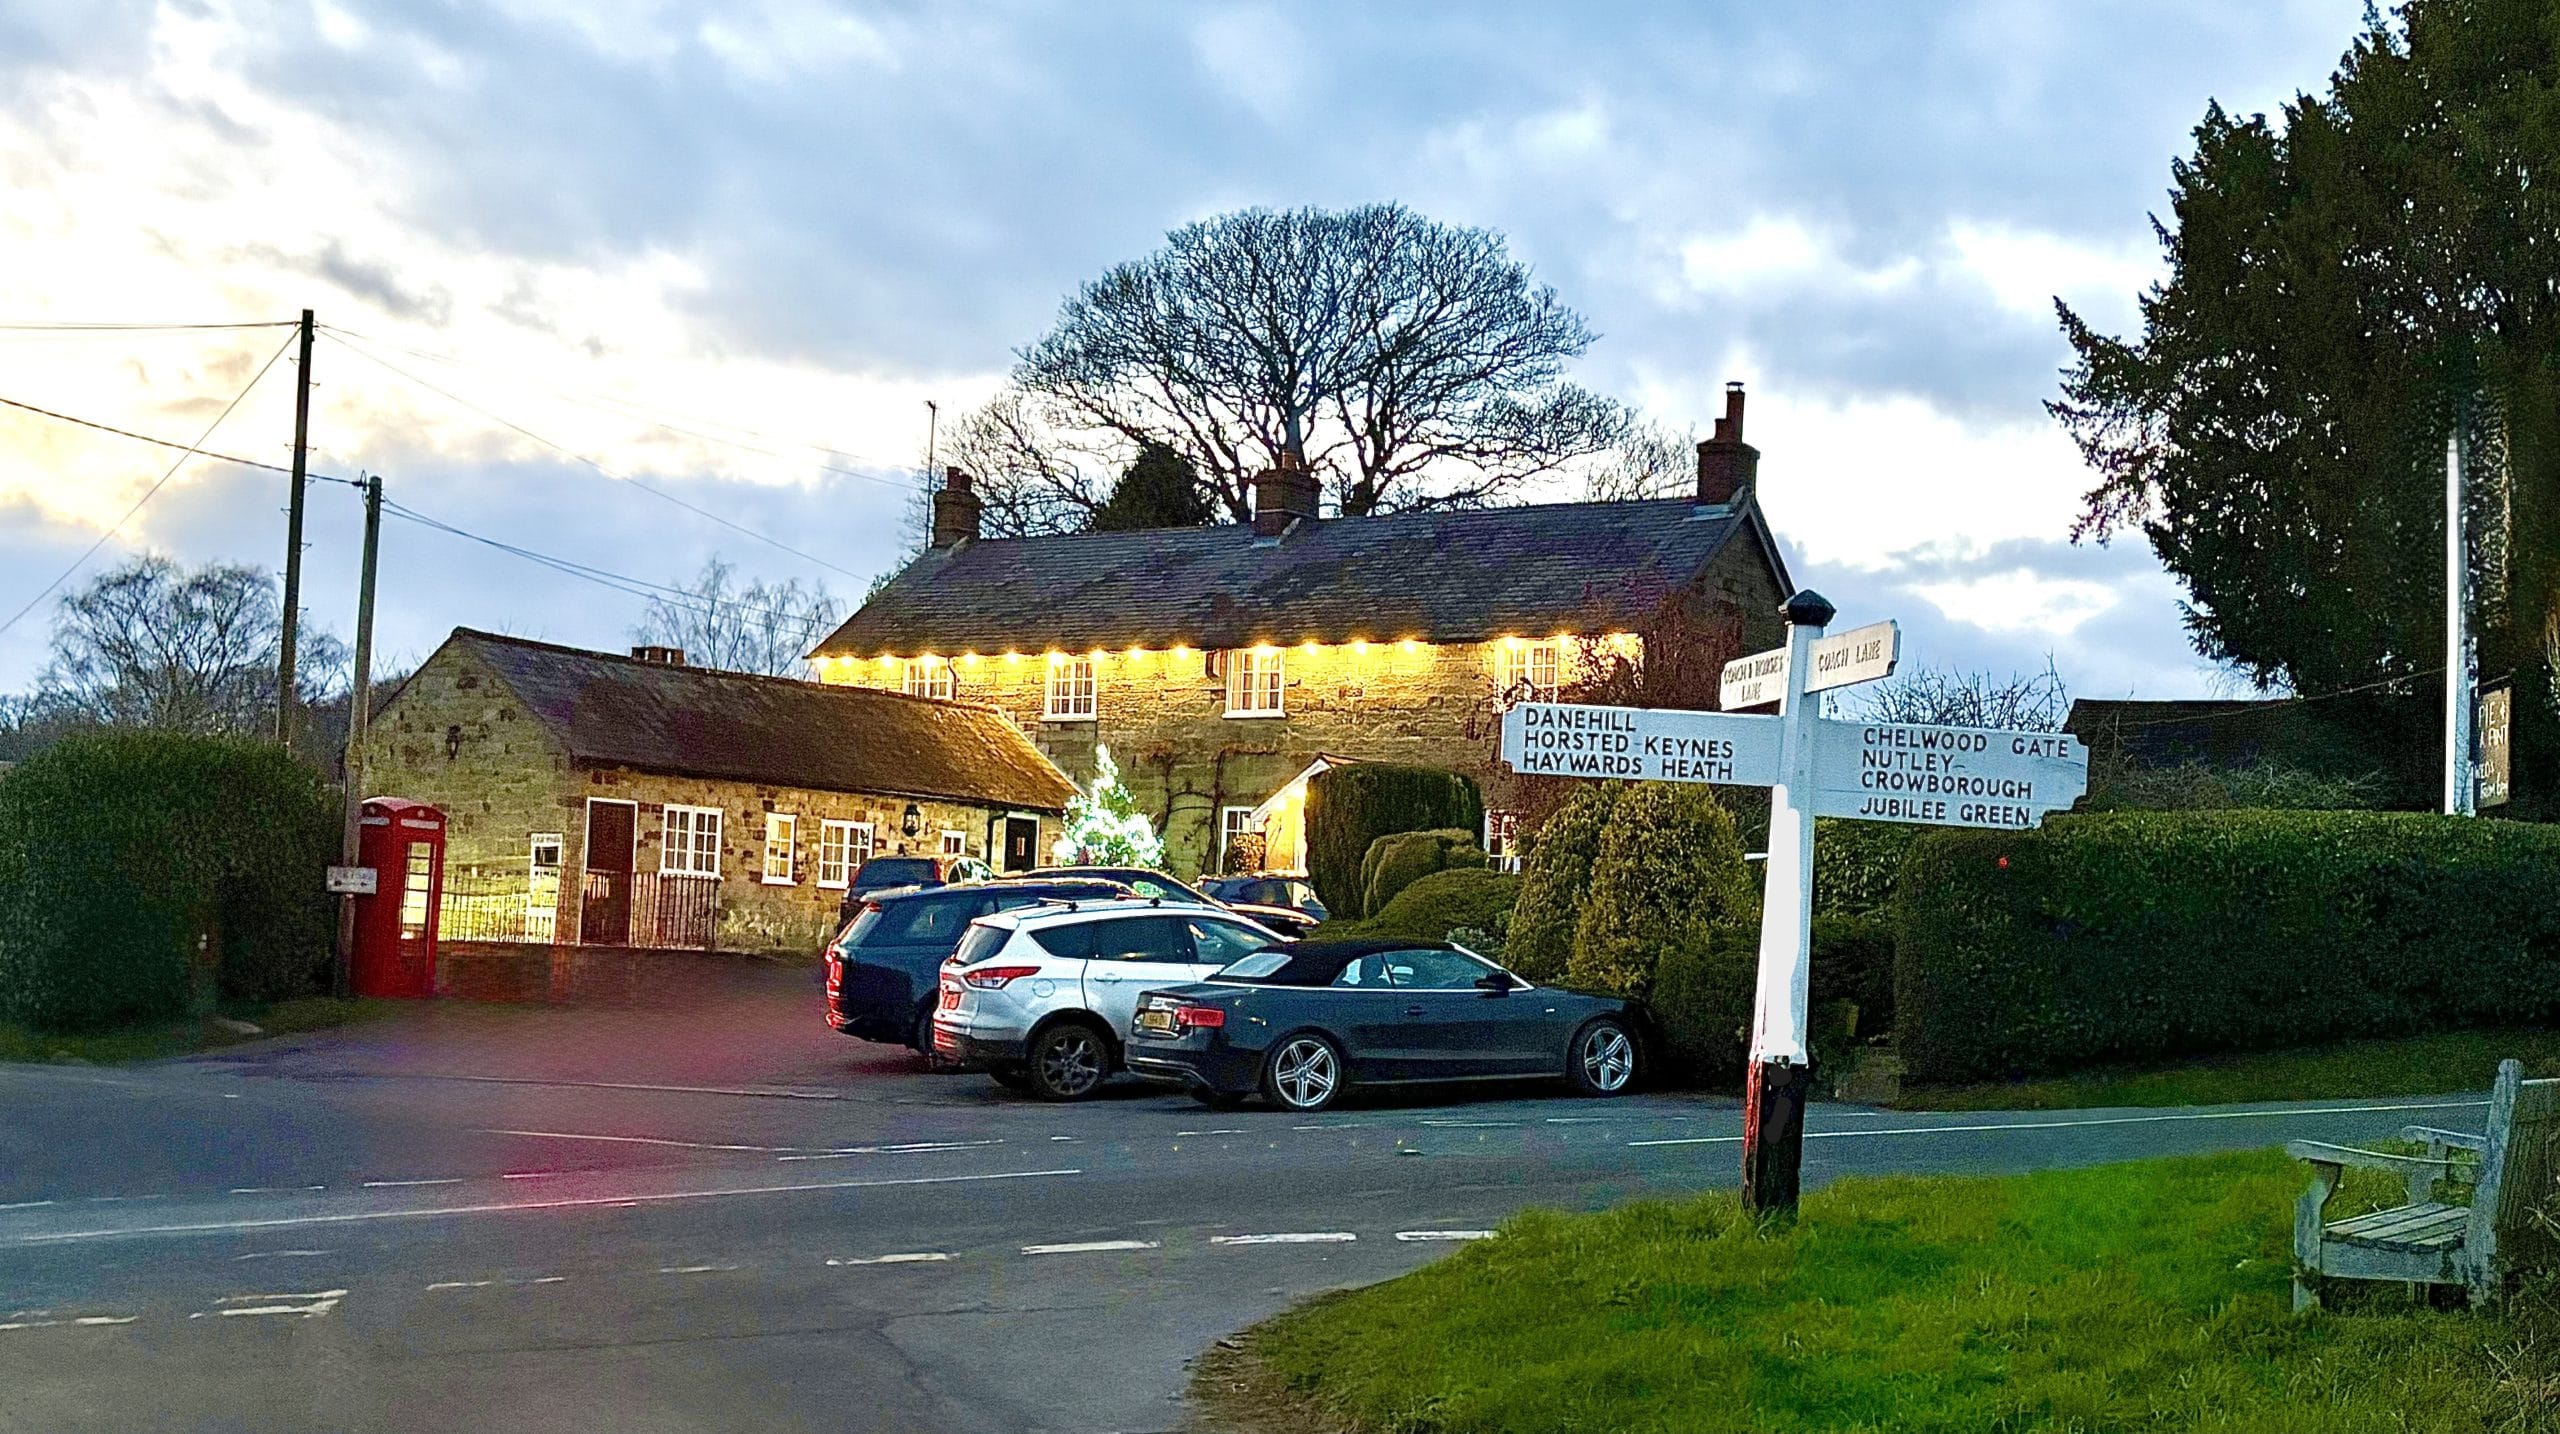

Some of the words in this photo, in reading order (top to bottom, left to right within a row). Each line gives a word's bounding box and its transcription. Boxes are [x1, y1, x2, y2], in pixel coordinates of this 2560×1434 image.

[1525, 707, 1637, 733] DANEHILL
[1864, 727, 1987, 752] CHELWOOD
[2012, 737, 2069, 758] GATE
[1523, 751, 1643, 775] HAYWARDS
[1661, 758, 1733, 780] HEATH
[1862, 749, 1954, 773] NUTLEY
[1861, 770, 2033, 800] CROWBOROUGH
[1860, 797, 1946, 820] JUBILEE
[1960, 803, 2030, 826] GREEN
